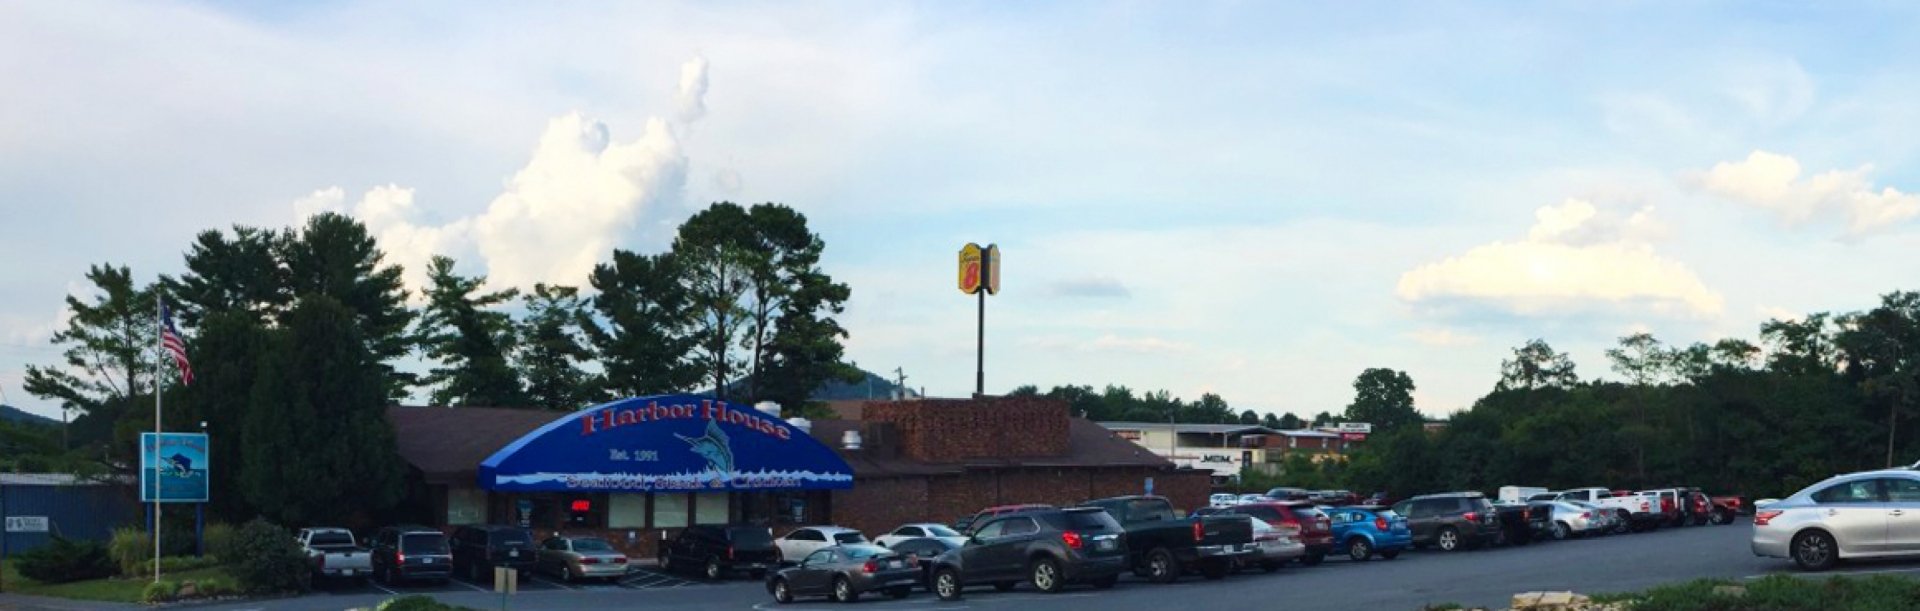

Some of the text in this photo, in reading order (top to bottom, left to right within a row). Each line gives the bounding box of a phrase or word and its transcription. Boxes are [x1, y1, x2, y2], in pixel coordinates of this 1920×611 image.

[963, 261, 979, 290] 8
[582, 400, 791, 440] Harbor House
[609, 449, 658, 461] Est. 1991
